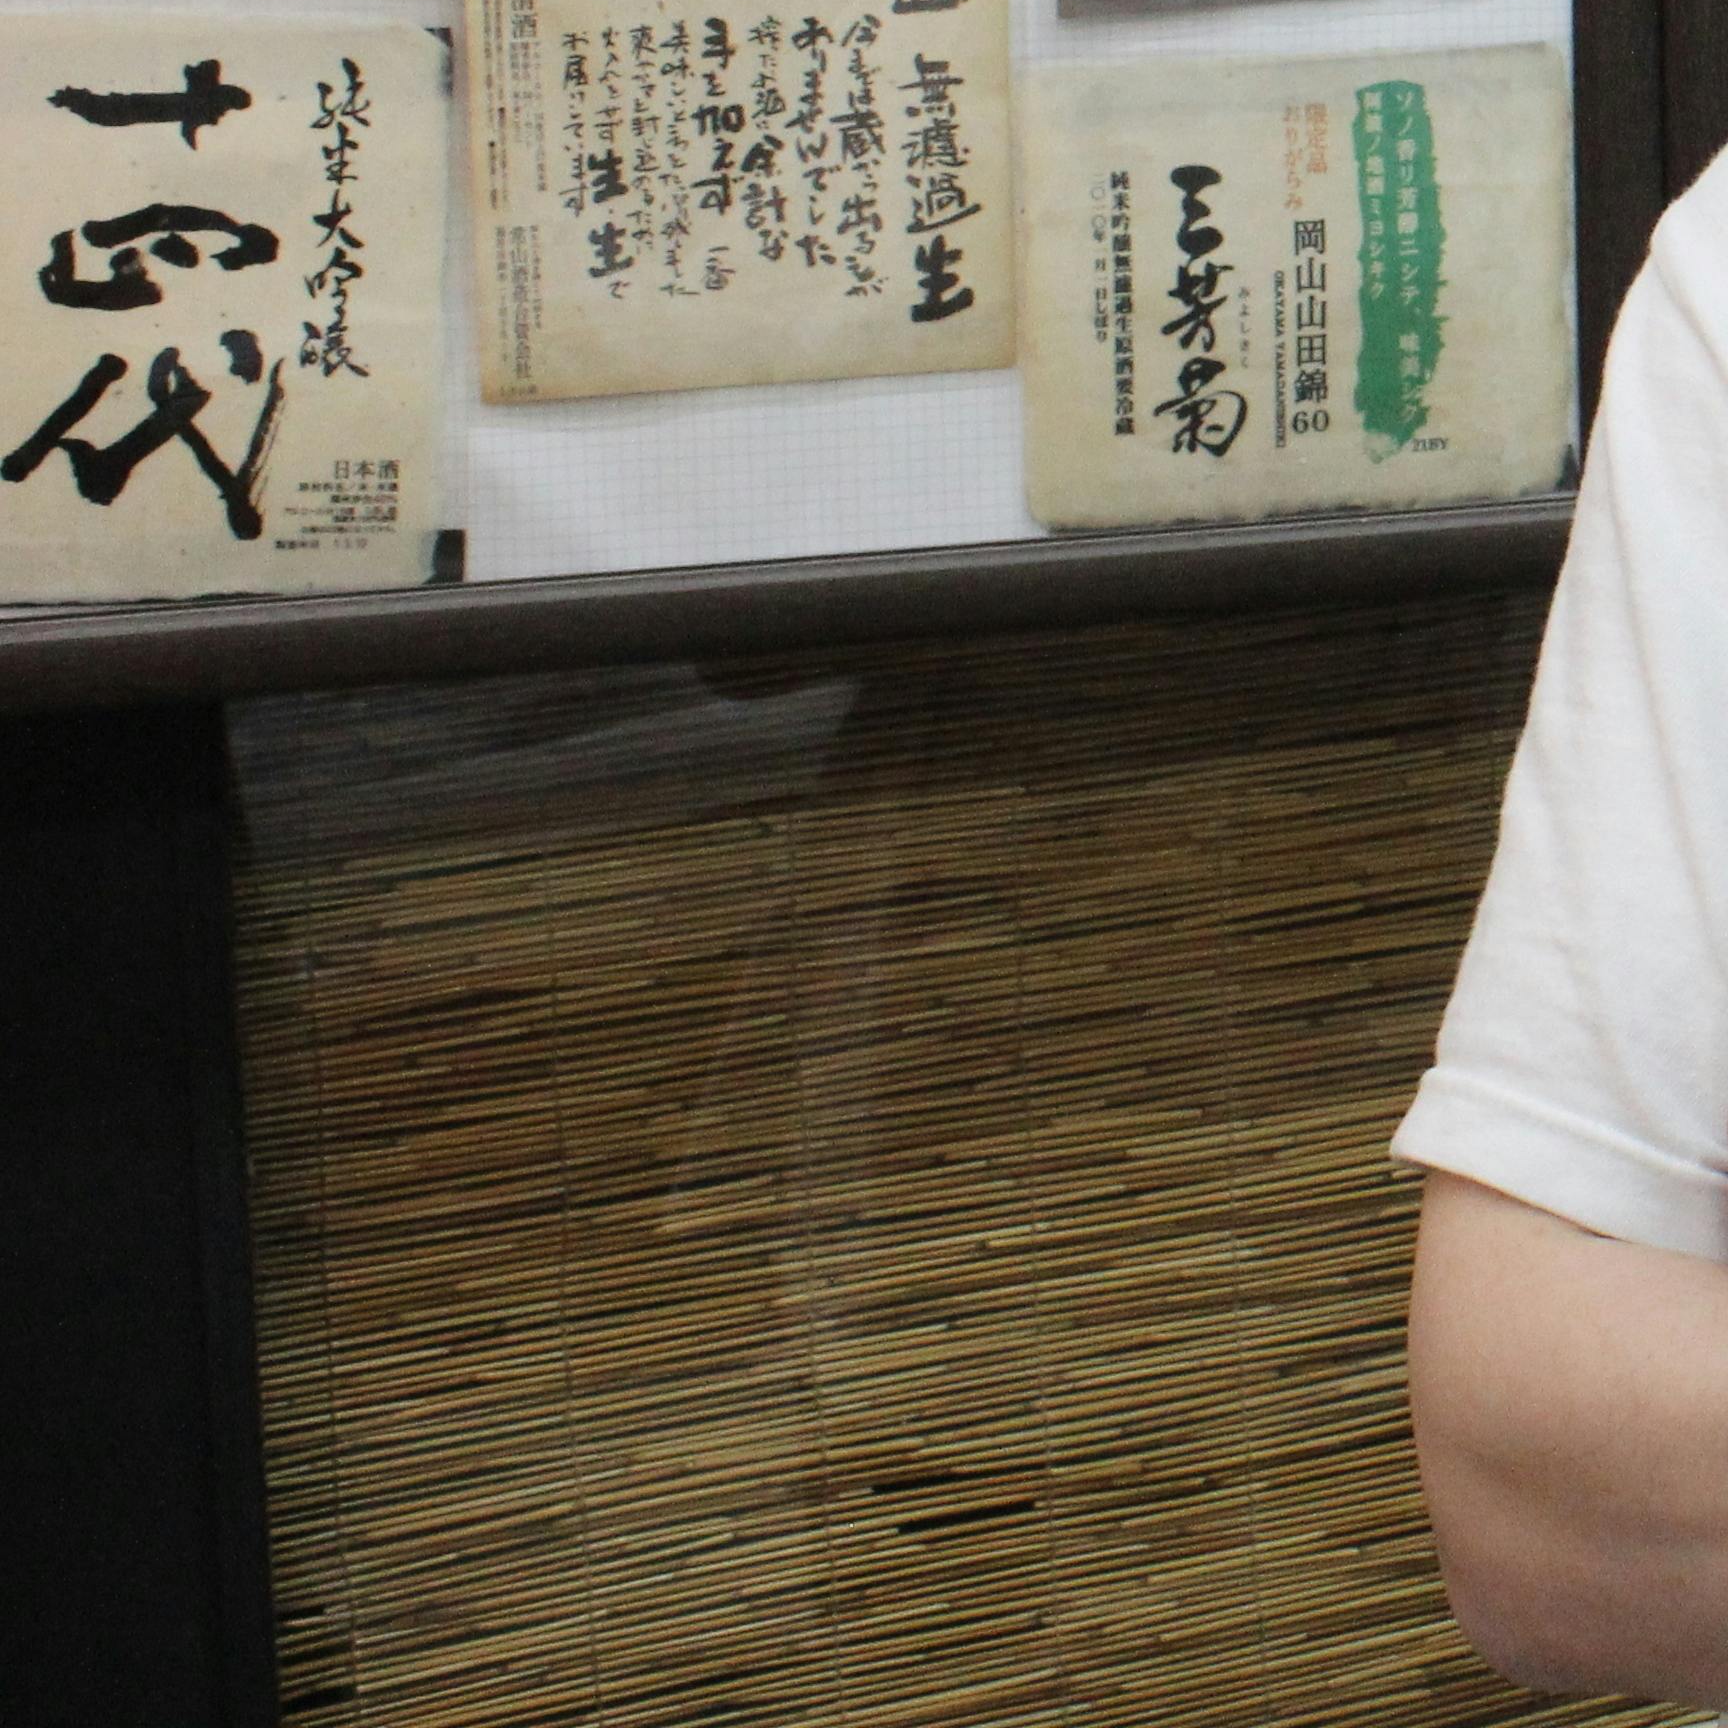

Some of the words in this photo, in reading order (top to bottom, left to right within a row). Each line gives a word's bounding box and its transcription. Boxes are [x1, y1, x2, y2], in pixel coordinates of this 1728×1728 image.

[0, 58, 281, 541] 十四代
[298, 57, 372, 378] 純米大吟醸
[1152, 164, 1249, 458] 三芳菊
[1272, 269, 1287, 339] OKAYAMA
[333, 459, 400, 480] 日本酒
